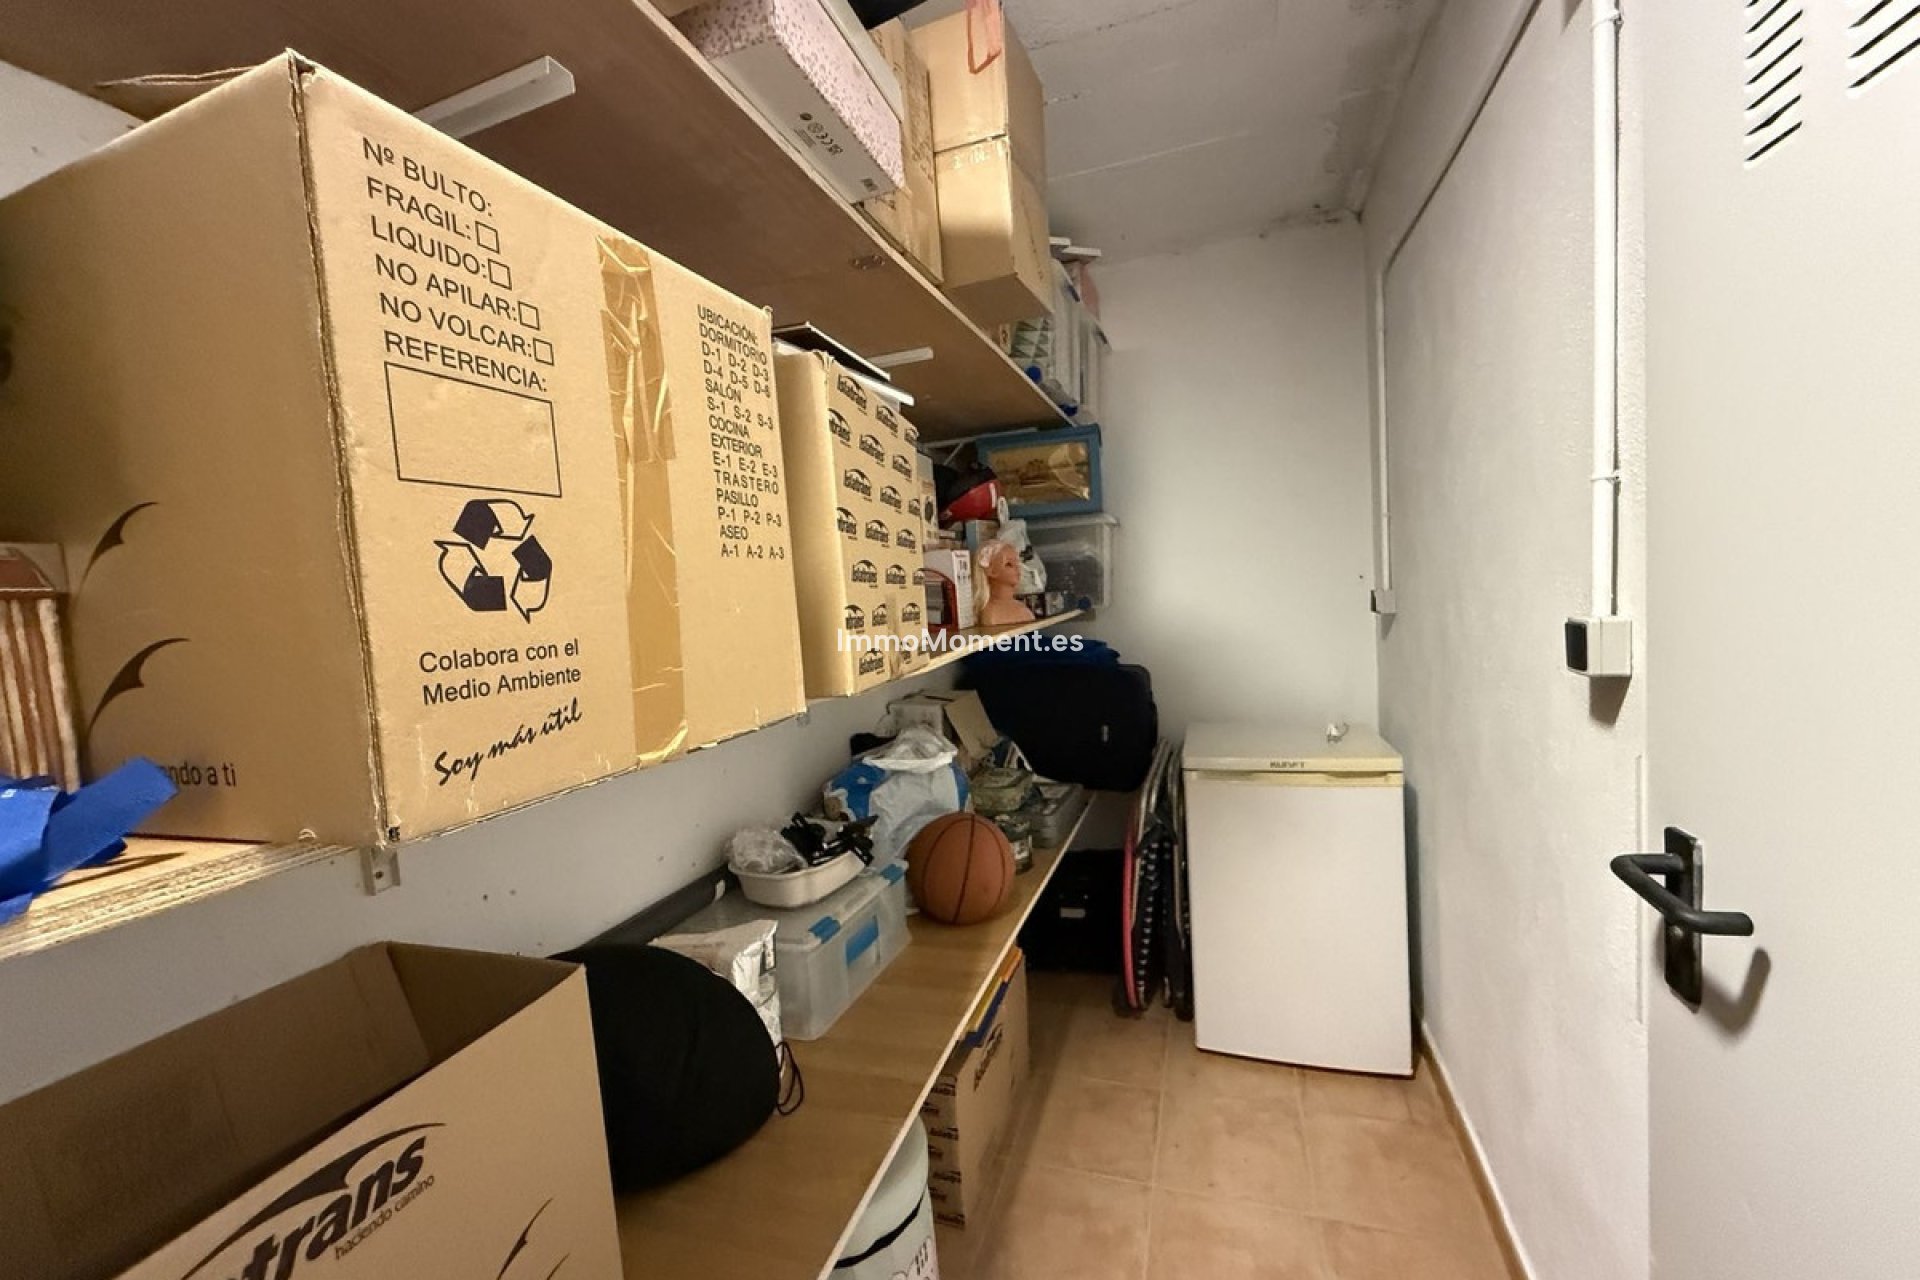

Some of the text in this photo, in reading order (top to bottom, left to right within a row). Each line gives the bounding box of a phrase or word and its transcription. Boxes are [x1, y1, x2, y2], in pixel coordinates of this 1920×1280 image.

[362, 137, 493, 217] Nº BULTO:
[367, 176, 472, 240] FRAGIL:
[371, 215, 487, 279] LIQUIDO:
[375, 253, 518, 321] NO APILAR:
[379, 292, 533, 358] NO VOLCAR:
[384, 329, 548, 393] REFERENCIA:
[699, 322, 767, 366] DORMITORIO
[702, 341, 769, 382] D-1 D-2 D-3
[703, 359, 723, 379] D-4
[730, 370, 749, 389] D-5
[707, 396, 774, 431] S-1 S-2 S-3
[708, 414, 751, 439] COCINA
[711, 432, 763, 459] EXTERIOR
[712, 450, 778, 479] E-1 E-2 E-3
[713, 469, 780, 495] TRASTERO
[716, 487, 759, 508] PASILLO
[718, 506, 782, 528] P-1 P-2 P-3
[720, 524, 749, 540] ASEO
[721, 543, 785, 561] A-1 A-2 A-3
[419, 637, 580, 673] Colabora con el
[422, 667, 582, 706] Medio Ambiente
[434, 696, 583, 787] Soy más útil
[207, 764, 219, 787] a
[222, 762, 238, 788] ti
[227, 1135, 427, 1280] trans
[335, 1174, 436, 1261] haciendo camino
